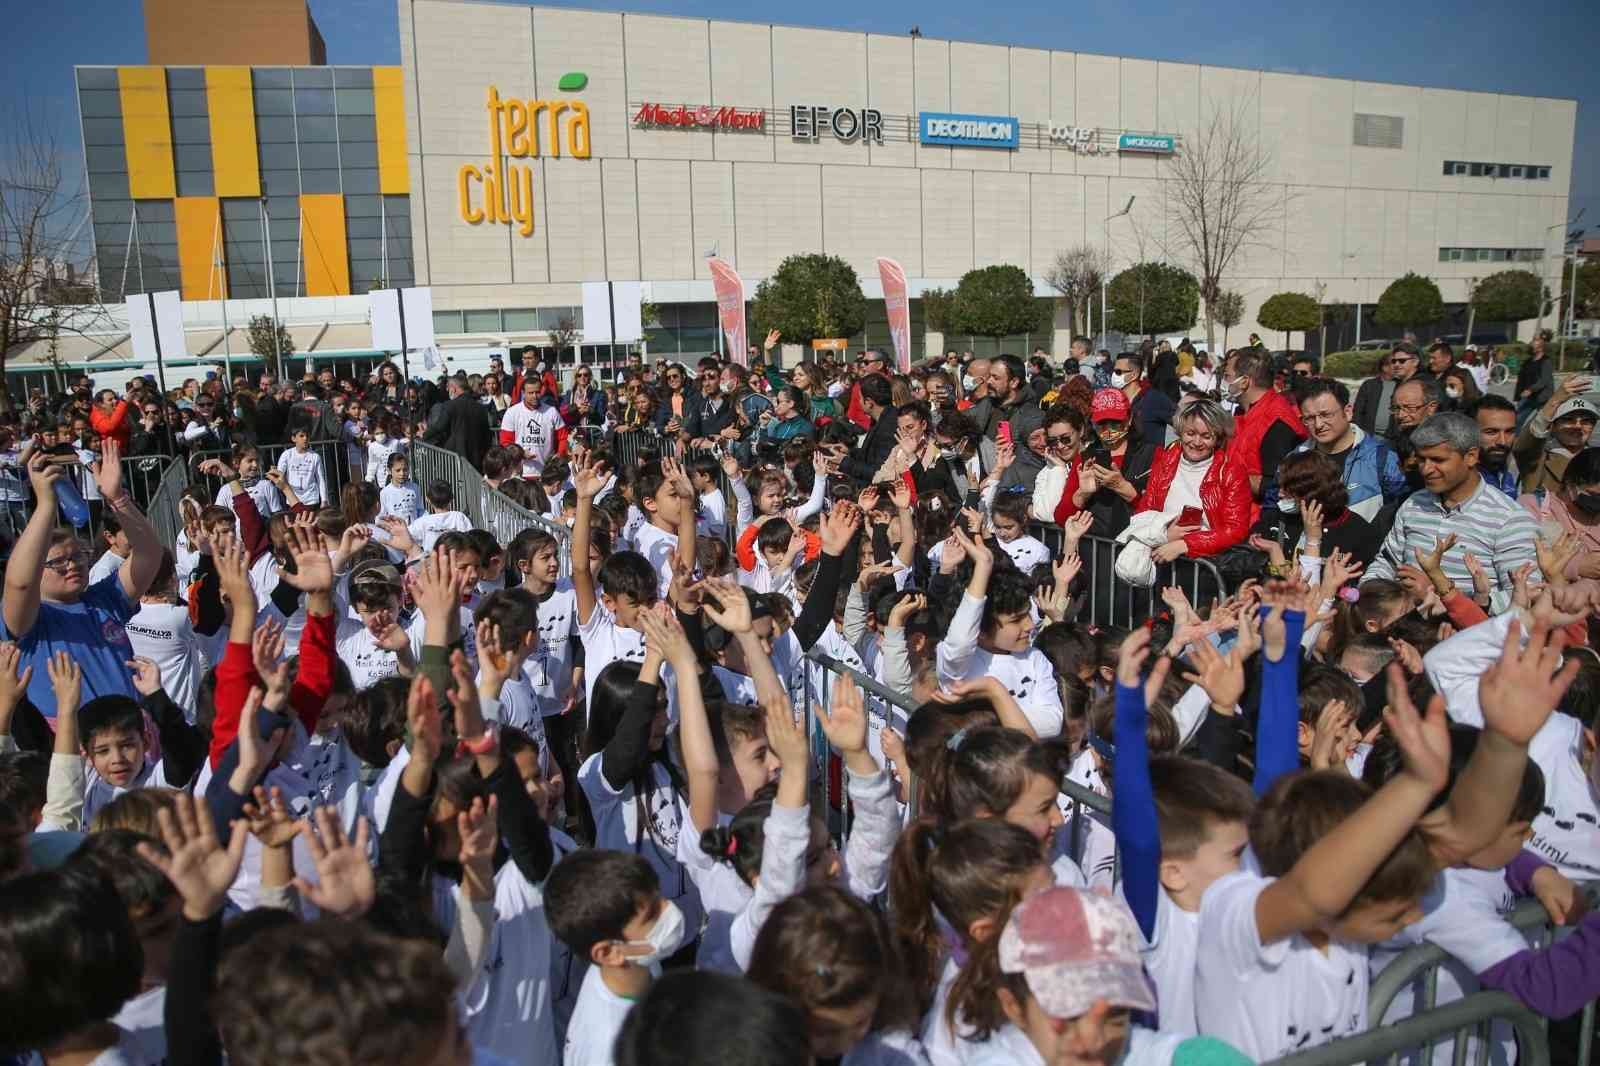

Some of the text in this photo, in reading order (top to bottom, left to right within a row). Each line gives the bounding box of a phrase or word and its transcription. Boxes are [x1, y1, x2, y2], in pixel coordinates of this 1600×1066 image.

[487, 85, 592, 160] terra
[790, 105, 883, 142] EFOR
[927, 118, 1012, 141] DECATHLON
[458, 163, 534, 237] city
